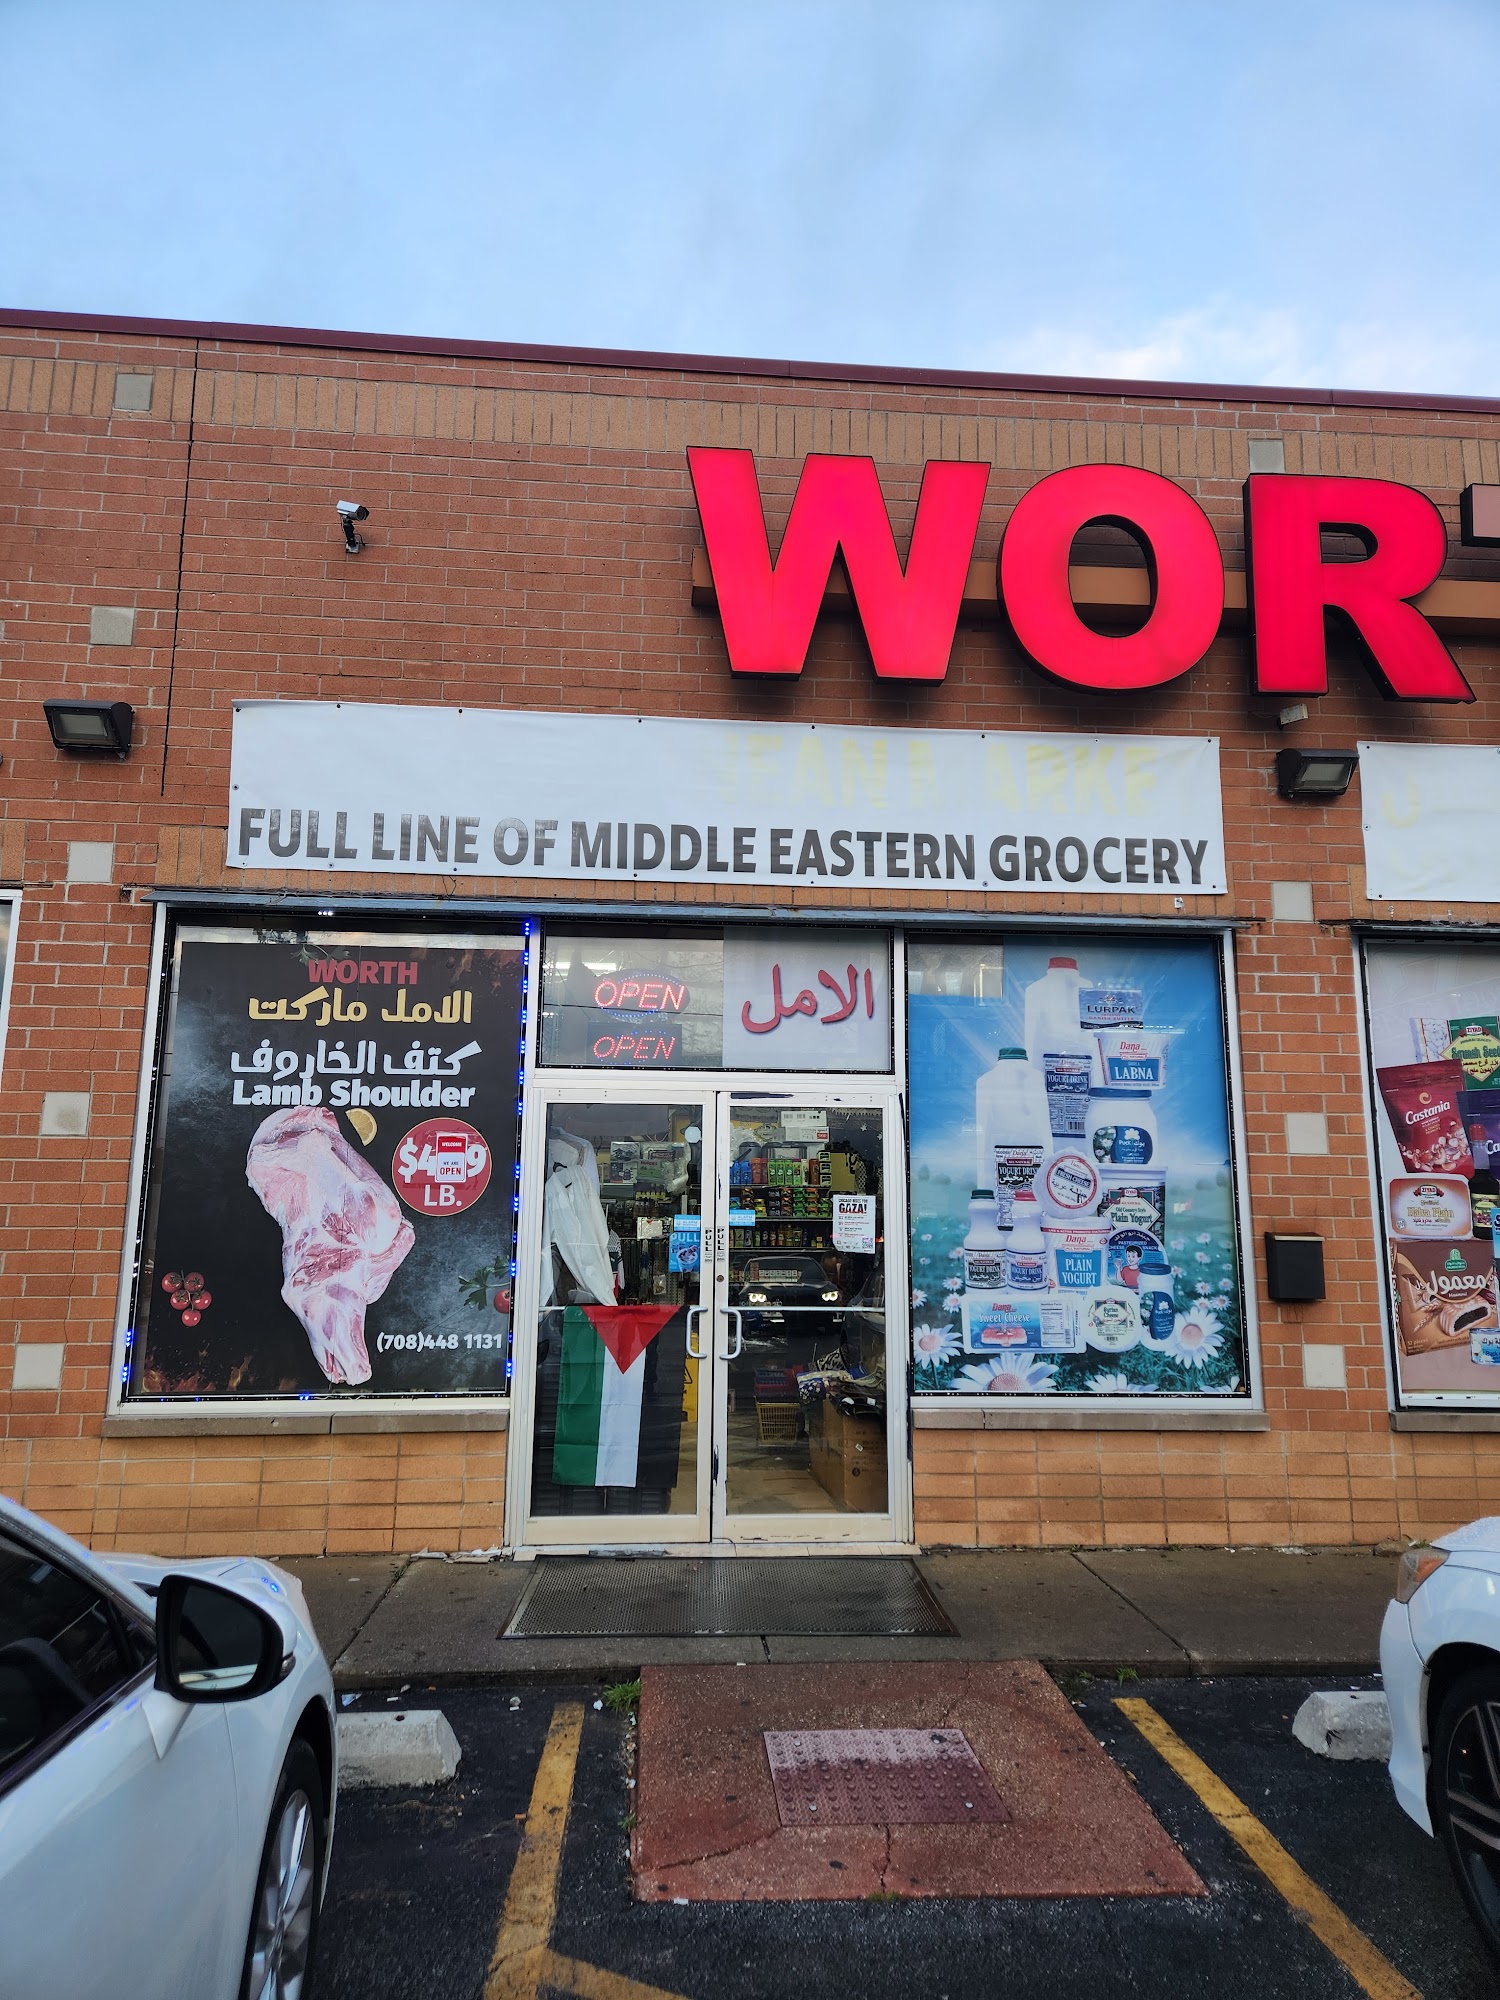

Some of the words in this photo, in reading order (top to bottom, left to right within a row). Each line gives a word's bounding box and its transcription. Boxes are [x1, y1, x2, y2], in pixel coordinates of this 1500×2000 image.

[687, 446, 1500, 704] WOR
[238, 807, 358, 860] FULL
[371, 812, 481, 864] LINE
[492, 817, 559, 867] OF
[569, 820, 757, 874] MIDDLE
[769, 828, 977, 882] EASTERN
[988, 834, 1209, 885] GROCERY
[308, 960, 418, 985] WORTH
[248, 986, 368, 1027] ماركت
[380, 988, 472, 1024] الامل
[593, 980, 685, 1011] OPEN
[742, 963, 875, 1034] الامل
[1087, 1005, 1136, 1014] LURPAK
[383, 1040, 483, 1077] كتف
[592, 1034, 676, 1060] OPEN
[230, 1039, 377, 1081] الخاروف
[1047, 1074, 1069, 1083] YOGURT
[1070, 1075, 1088, 1084] DRINK
[1114, 1066, 1154, 1080] LABNA
[232, 1079, 323, 1107] Lamb
[328, 1079, 476, 1109] Shoulder
[1405, 1101, 1451, 1125] Castania
[397, 1137, 487, 1184] $49
[440, 1167, 462, 1175] OPEN
[999, 1166, 1022, 1175] YOGURT
[423, 1184, 463, 1207] LB.
[838, 1203, 867, 1214] GAZA!
[1110, 1212, 1129, 1223] Plain
[1129, 1212, 1153, 1226] Yogurt
[670, 1232, 700, 1243] PULL
[704, 1229, 713, 1252] PULL
[717, 1227, 725, 1251] PULL
[1065, 1234, 1087, 1244] Dana
[1065, 1258, 1093, 1271] PLAIN
[1061, 1271, 1097, 1285] YOGURT
[1426, 1270, 1488, 1296] معمول
[979, 1313, 1001, 1323] Sweet
[1004, 1312, 1031, 1323] Cheese
[376, 1333, 459, 1353] (708)448
[463, 1333, 502, 1350] 1131
